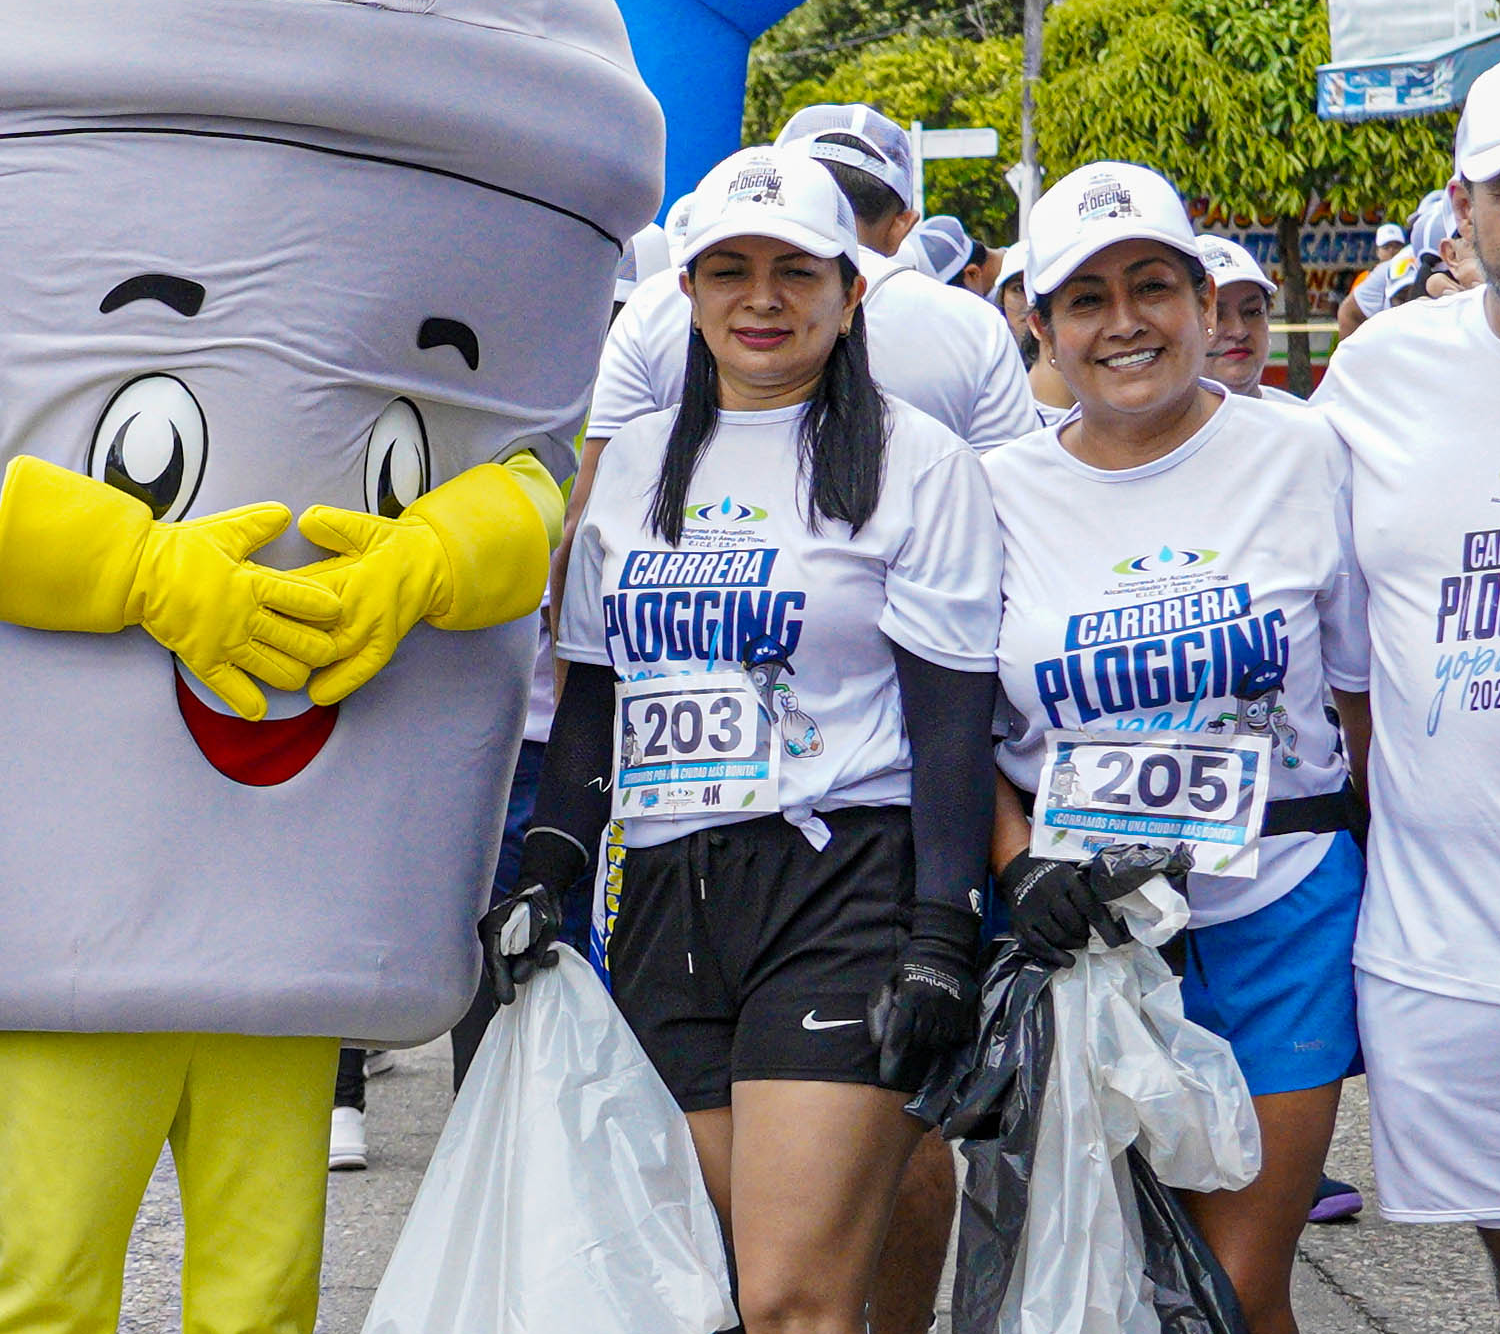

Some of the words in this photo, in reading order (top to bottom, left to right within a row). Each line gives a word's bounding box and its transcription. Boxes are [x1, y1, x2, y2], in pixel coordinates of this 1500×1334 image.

[628, 550, 764, 586] CARRRERA
[602, 590, 806, 667] PLOGGING
[1077, 588, 1242, 646] CARRRERA
[1034, 608, 1289, 728] PLOGGING
[644, 696, 743, 758] 203
[701, 783, 722, 807] 4K
[1092, 750, 1229, 813] 205
[1108, 818, 1126, 830] POR
[1128, 819, 1146, 832] UNA
[905, 973, 961, 1000] Titanium
